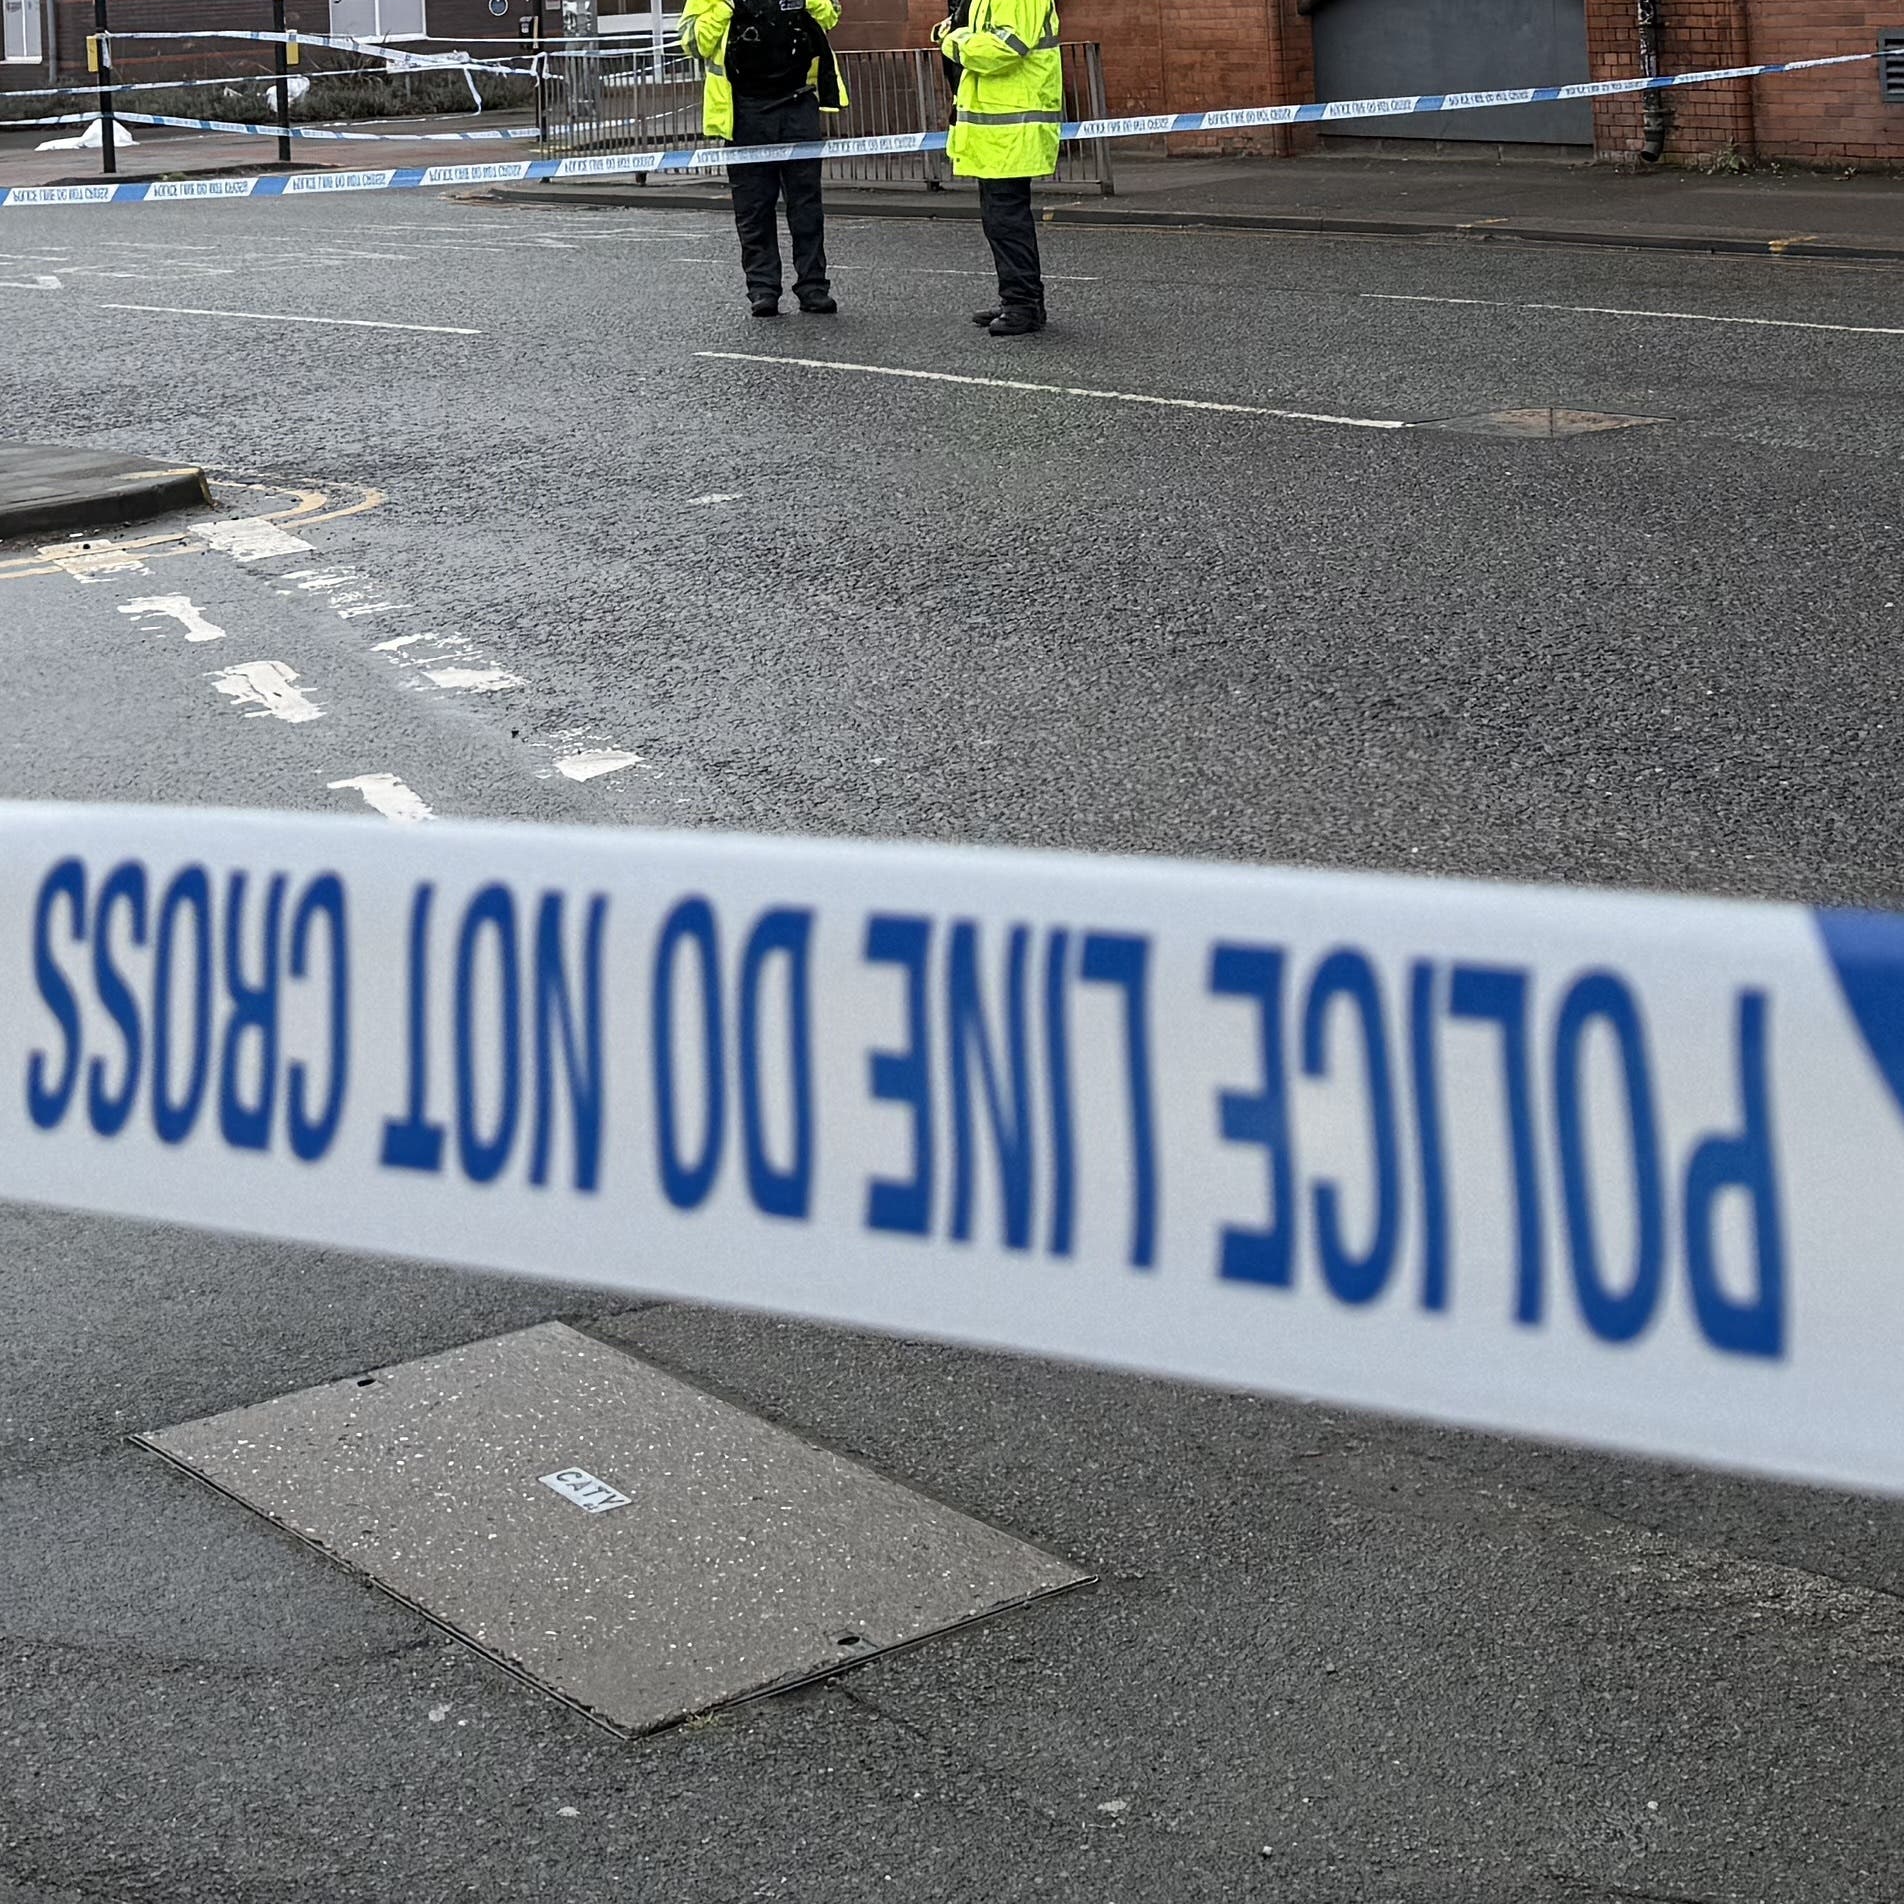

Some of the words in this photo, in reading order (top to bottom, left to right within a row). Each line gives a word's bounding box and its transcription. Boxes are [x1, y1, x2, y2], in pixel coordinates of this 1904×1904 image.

[27, 856, 348, 1163] CROSS
[380, 882, 609, 1195] NOT
[651, 895, 815, 1222] DO
[863, 912, 1158, 1271] LINE
[1208, 941, 1787, 1365] POLICE
